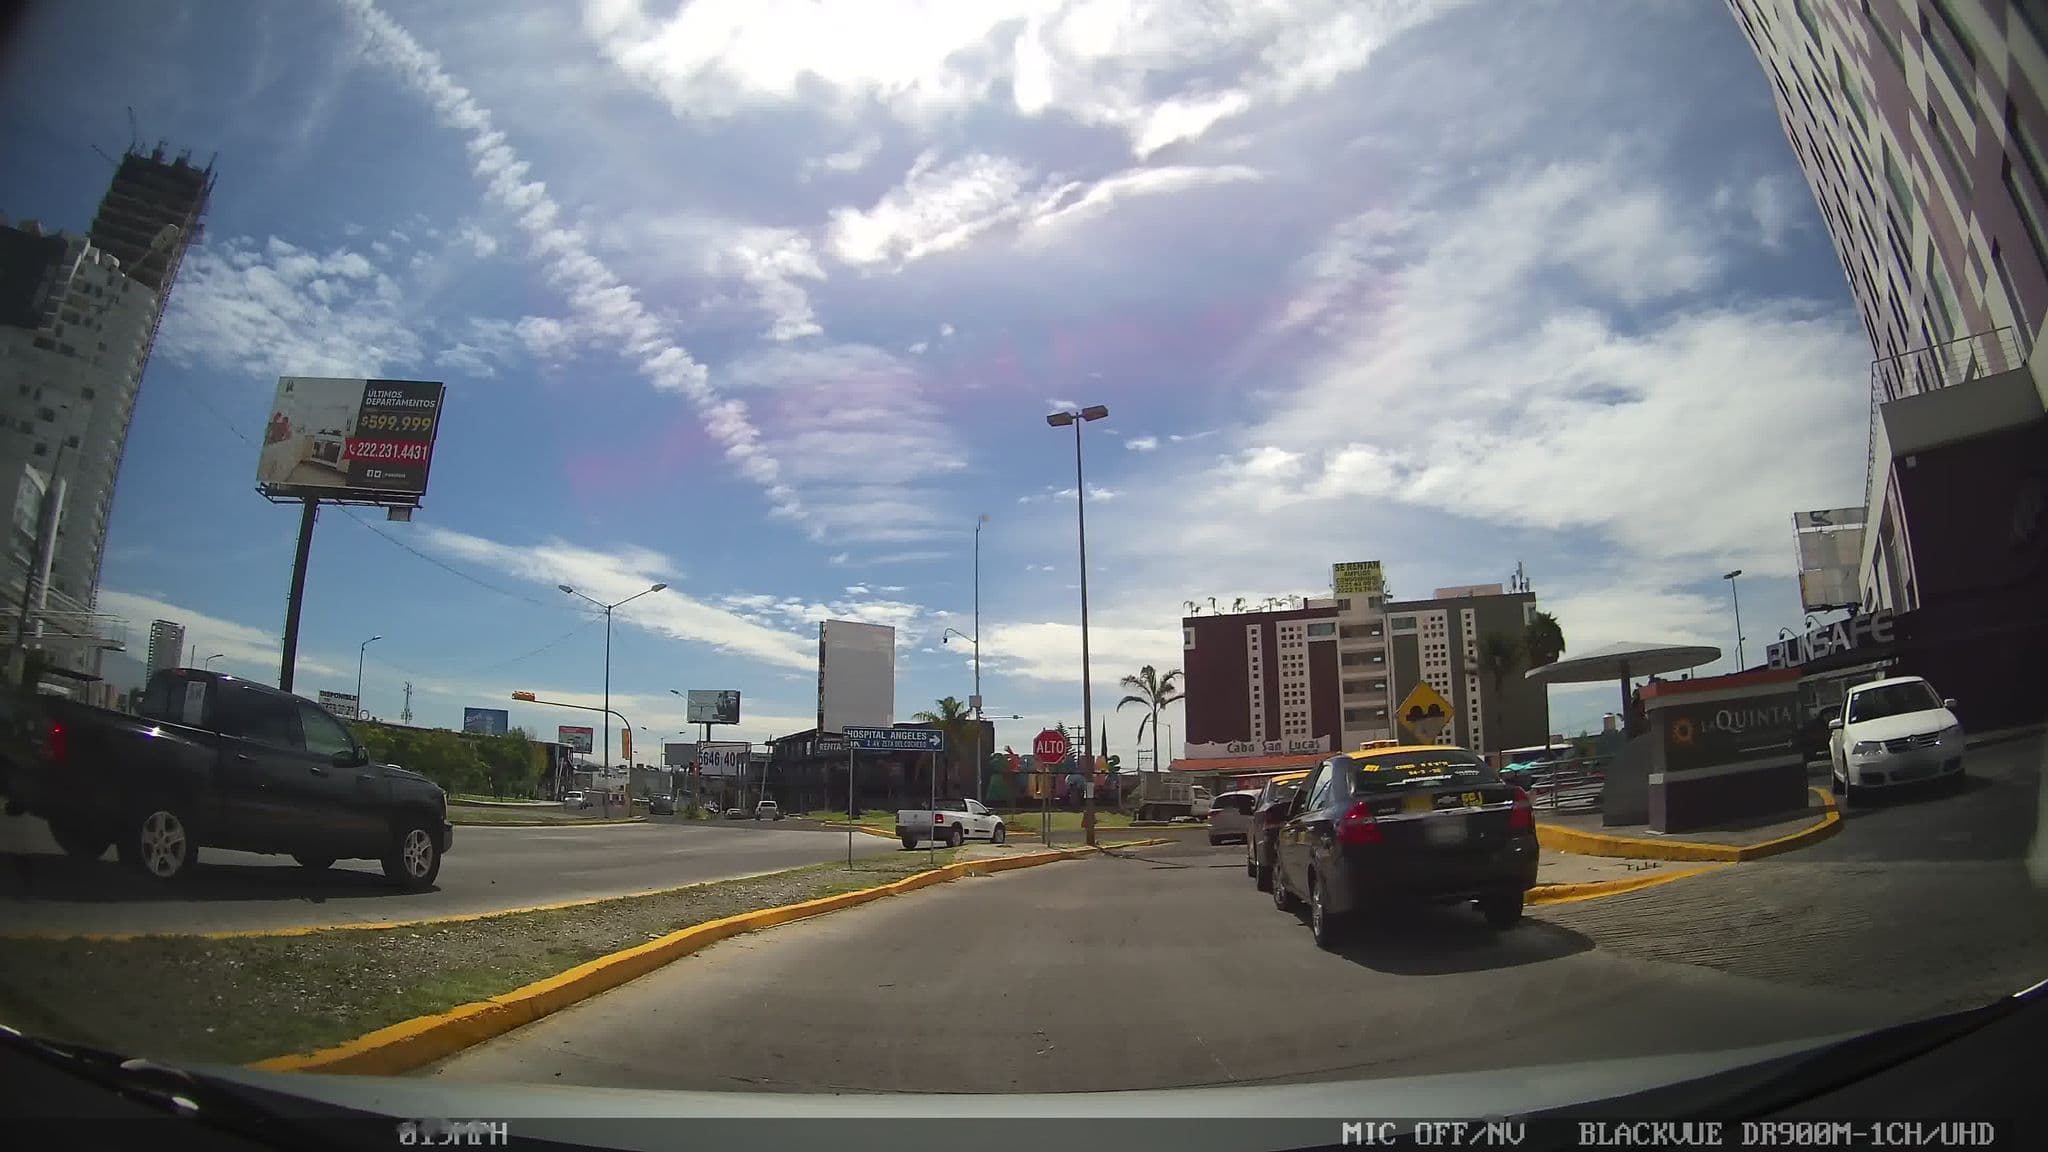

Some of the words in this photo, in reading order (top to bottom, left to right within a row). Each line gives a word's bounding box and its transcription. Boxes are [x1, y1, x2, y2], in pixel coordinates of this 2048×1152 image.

[365, 397, 436, 408] DEPARTAMENTOS
[356, 442, 428, 461] 222.231.4431
[1335, 564, 1345, 572] SE
[1346, 561, 1380, 571] RENTAN
[319, 690, 358, 701] DISPONIBLE
[1715, 706, 1792, 733] QUINTA
[847, 730, 886, 740] HOSPITAL
[890, 732, 927, 740] ANGELES
[1036, 741, 1064, 754] ALTO
[1226, 743, 1255, 753] Cabo
[1262, 741, 1282, 752] San
[1288, 739, 1320, 750] Lucas
